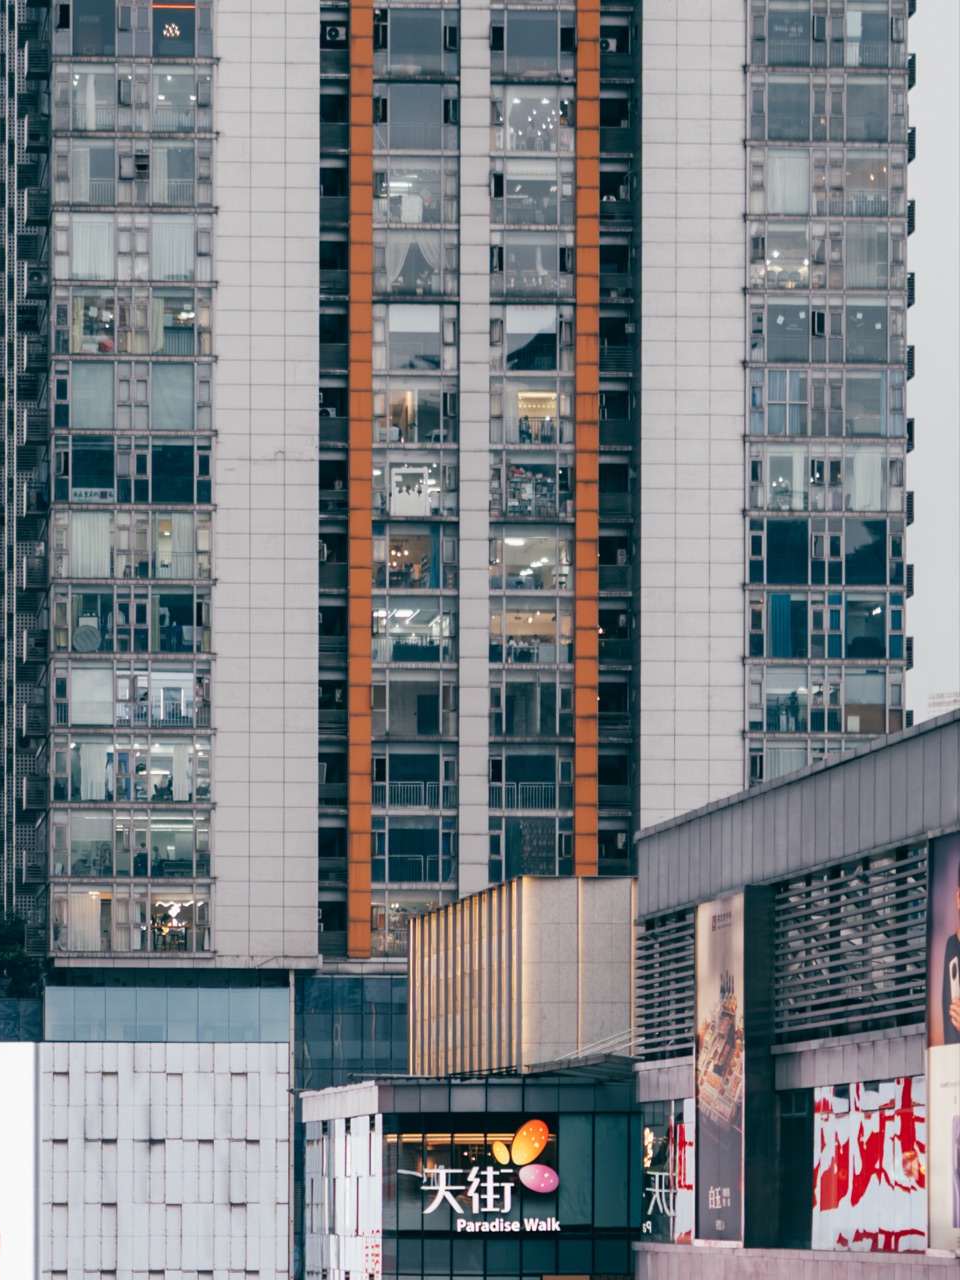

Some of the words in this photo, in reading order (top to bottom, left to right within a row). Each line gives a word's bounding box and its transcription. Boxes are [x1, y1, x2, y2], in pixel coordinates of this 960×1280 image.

[420, 1165, 515, 1215] 天街
[456, 1217, 521, 1233] Paradise
[523, 1217, 561, 1232] Walk
